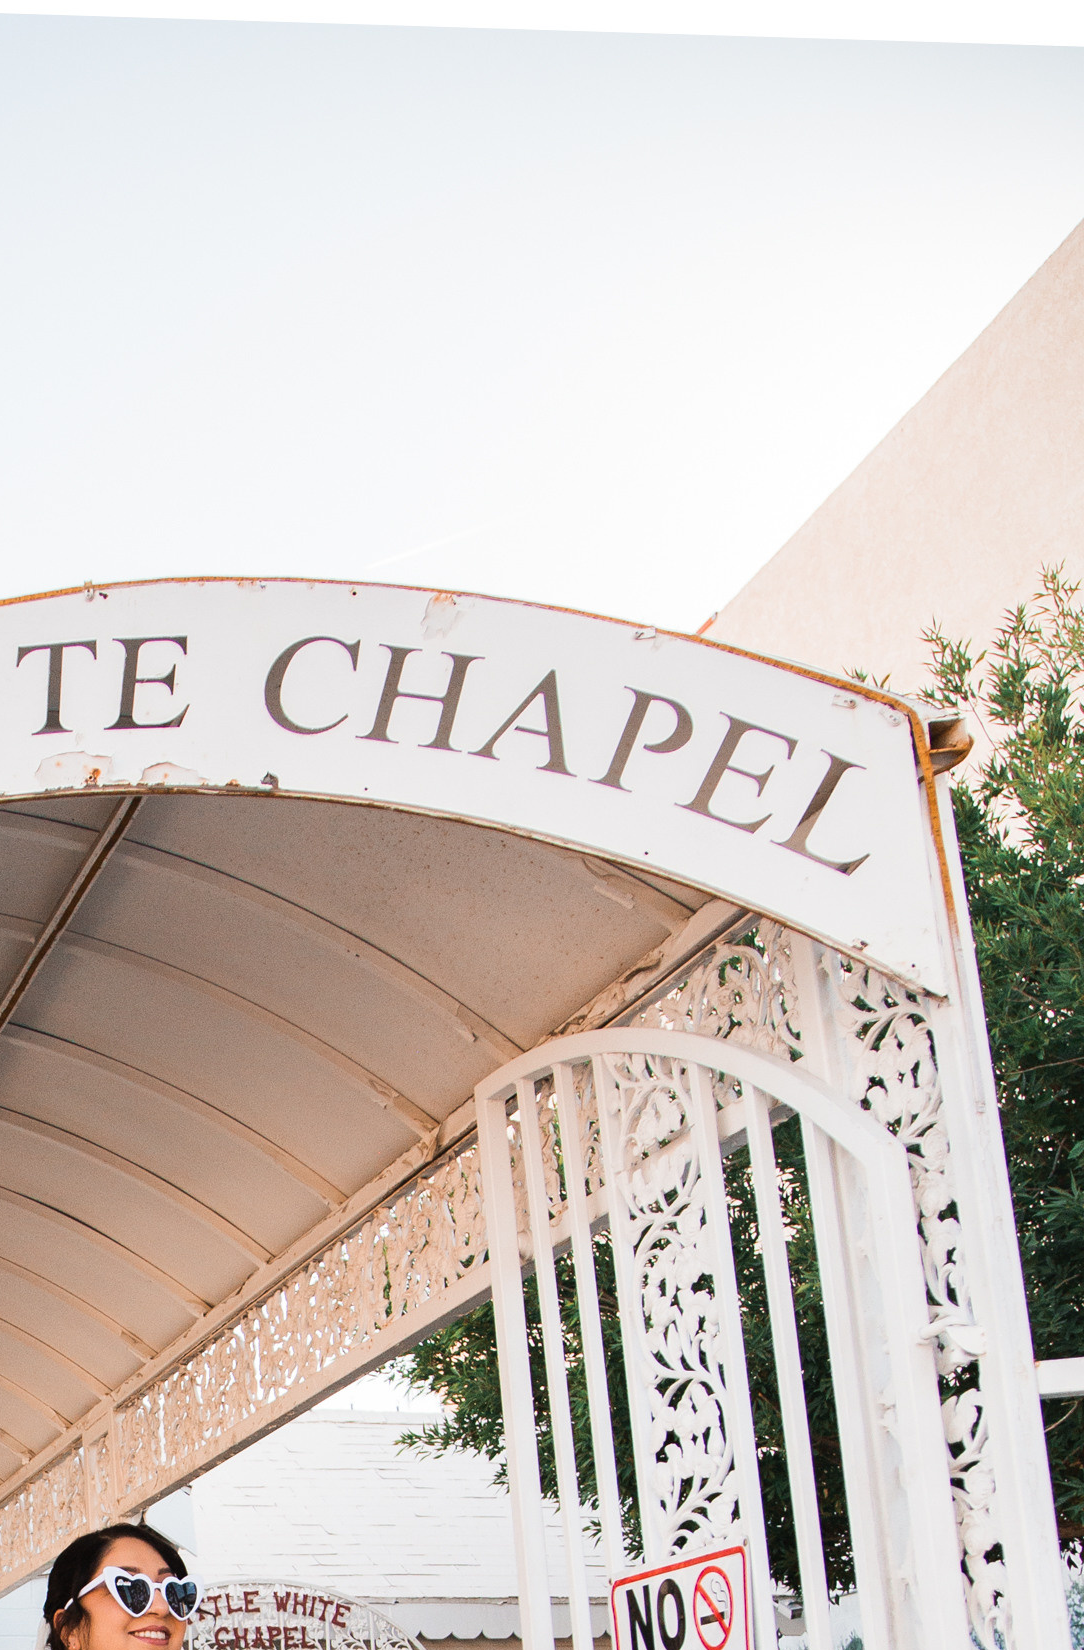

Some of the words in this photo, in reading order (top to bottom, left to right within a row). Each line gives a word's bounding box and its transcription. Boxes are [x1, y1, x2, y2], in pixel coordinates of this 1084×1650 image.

[264, 636, 871, 876] CHAPEL
[187, 1591, 260, 1625] TLE
[273, 1591, 350, 1628] WHITE
[215, 1626, 316, 1650] CHAPEL
